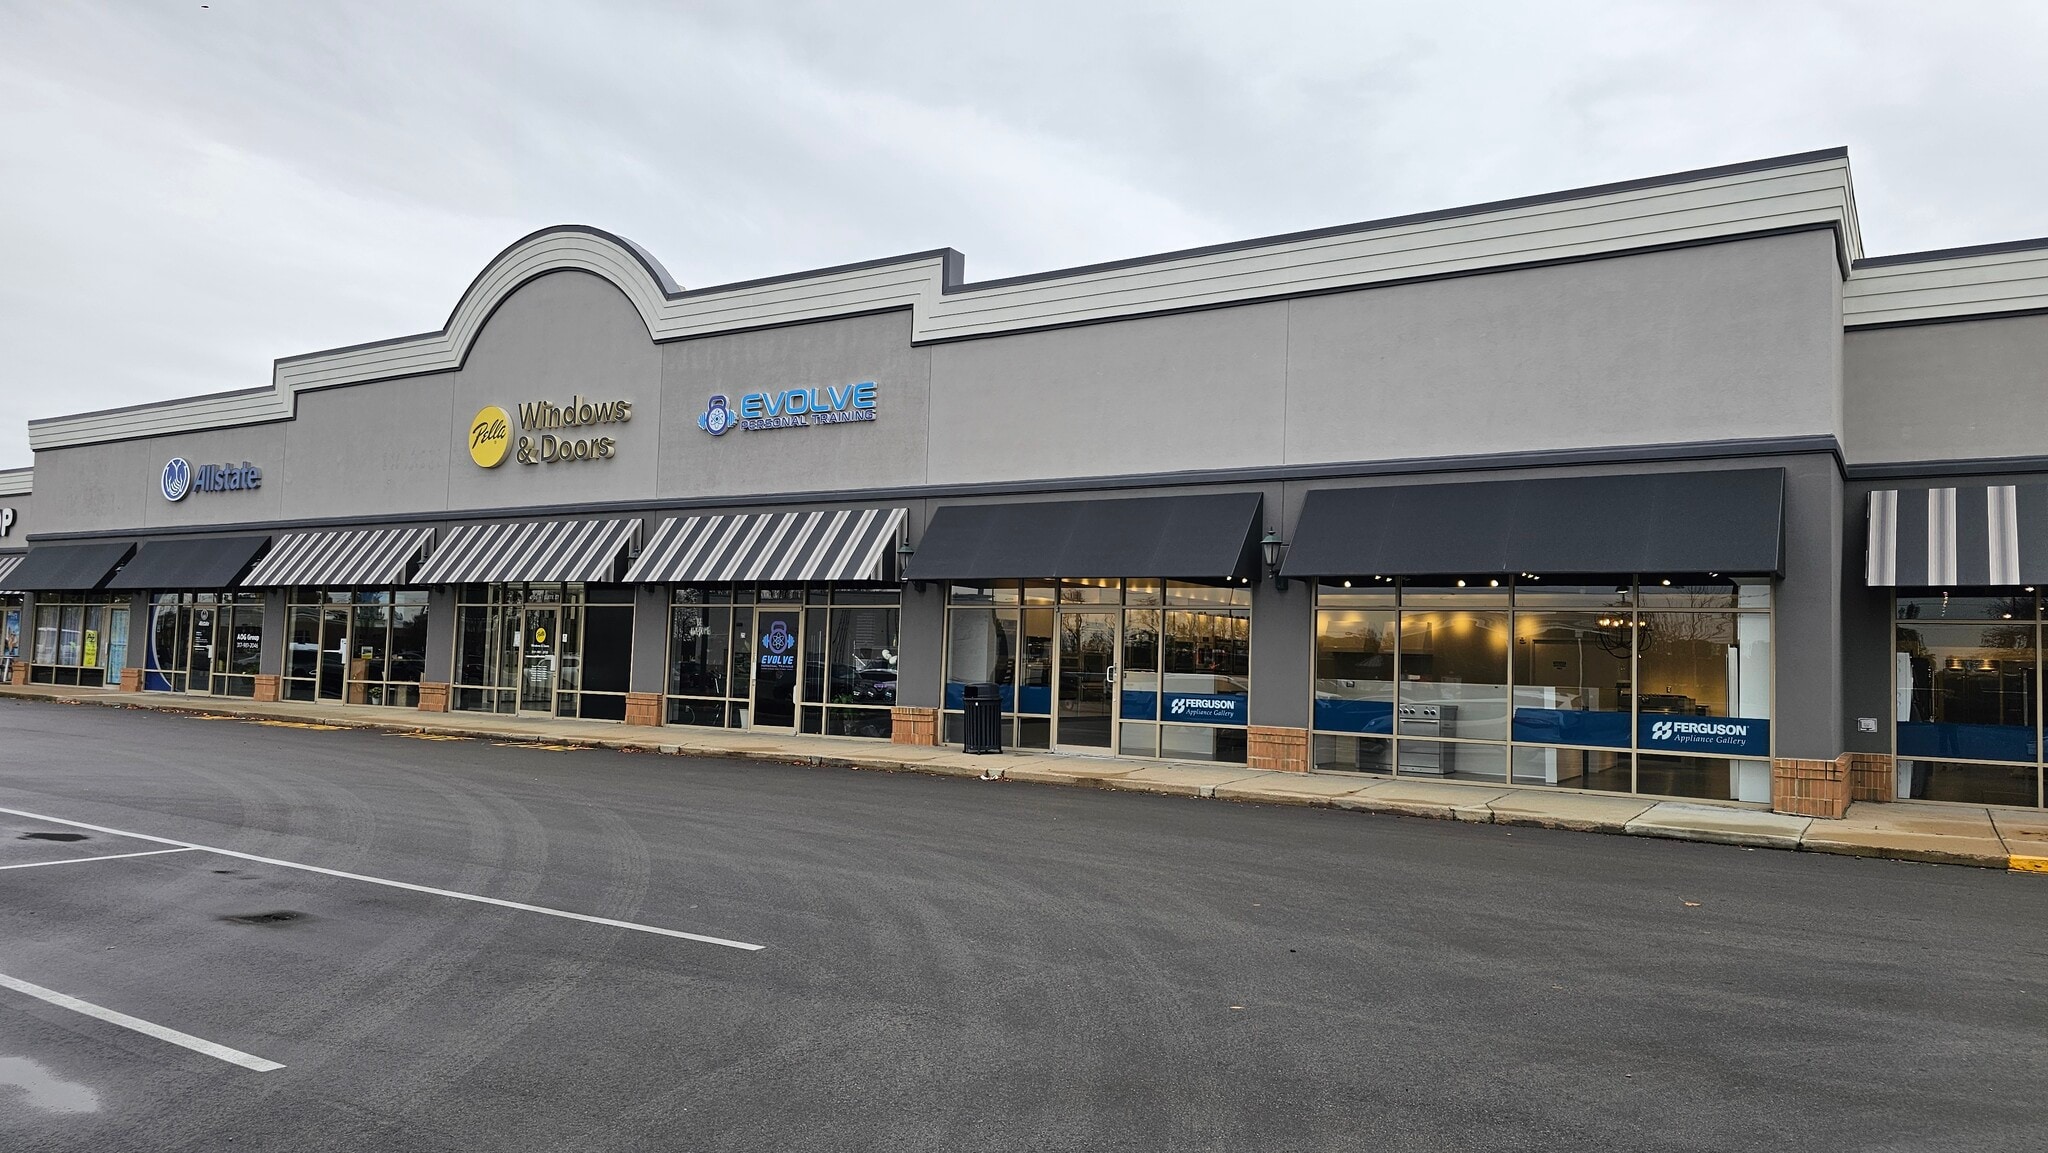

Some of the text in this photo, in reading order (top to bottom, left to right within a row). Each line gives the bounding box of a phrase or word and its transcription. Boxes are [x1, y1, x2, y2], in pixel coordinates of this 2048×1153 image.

[740, 381, 877, 419] EVOLVE
[518, 395, 632, 430] Windows
[740, 409, 877, 431] PERSONAL TRAINING
[472, 418, 507, 450] Pella
[516, 434, 616, 465] & Doors
[193, 461, 262, 493] Allstate
[761, 655, 794, 665] EVOLVE
[1185, 698, 1235, 710] FERGUSON
[1185, 708, 1234, 719] Appliance Gallery
[1673, 721, 1747, 736] FERGUSON
[1673, 734, 1747, 747] Appliance Gallery
